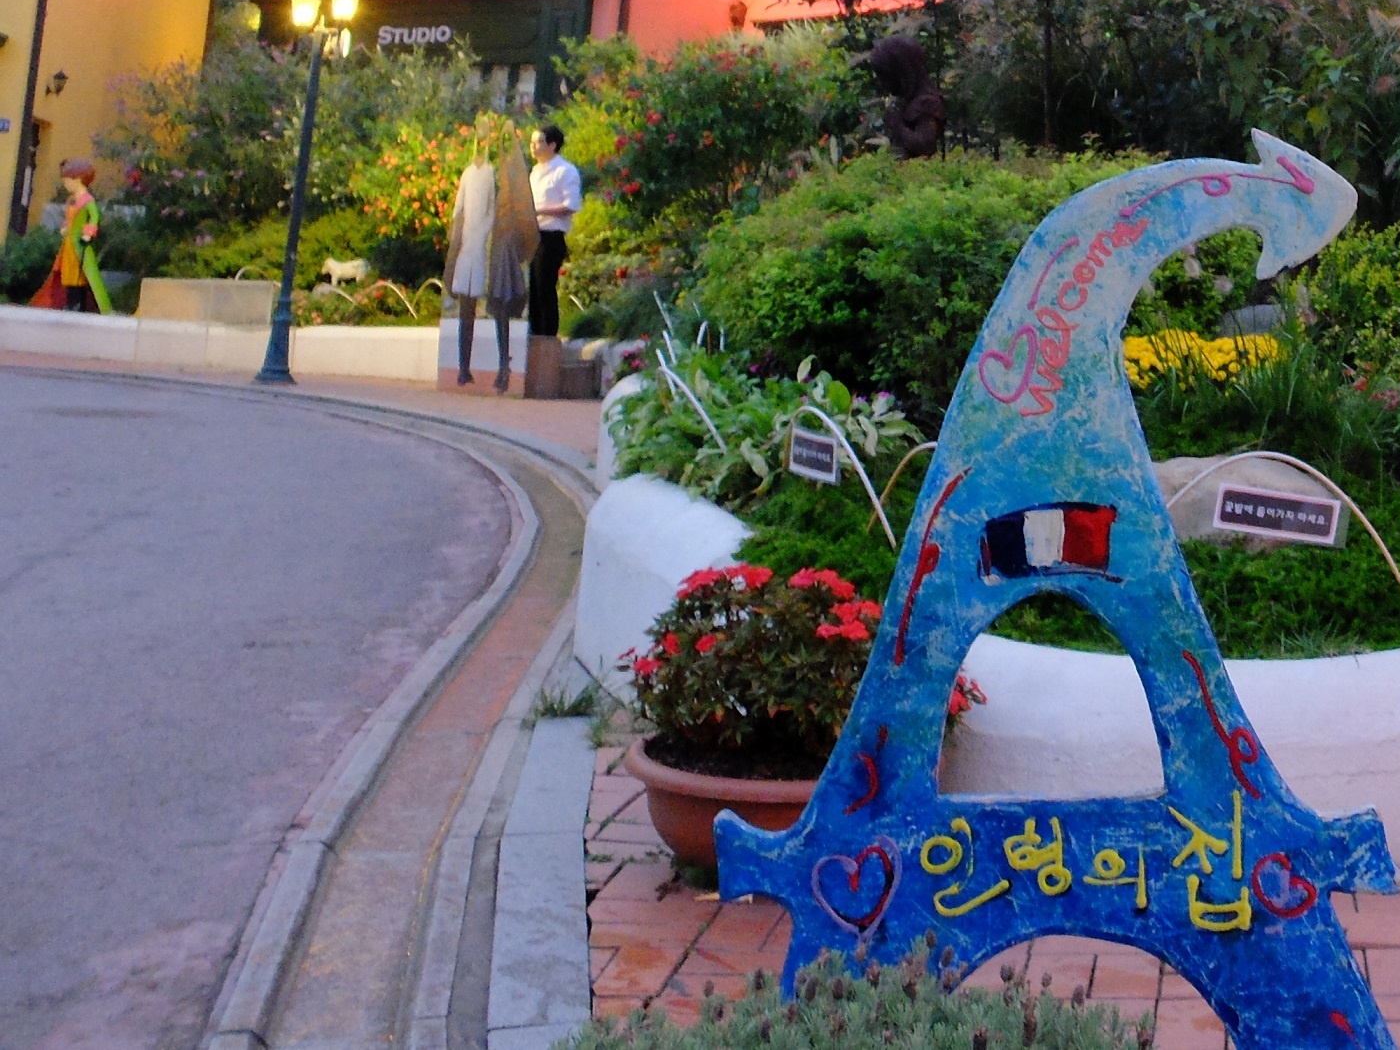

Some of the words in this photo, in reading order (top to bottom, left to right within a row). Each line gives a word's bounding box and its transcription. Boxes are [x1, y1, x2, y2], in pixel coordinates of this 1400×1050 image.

[378, 25, 452, 45] STUDIO
[920, 817, 1147, 917] 인형의
[1168, 789, 1253, 932] 집
